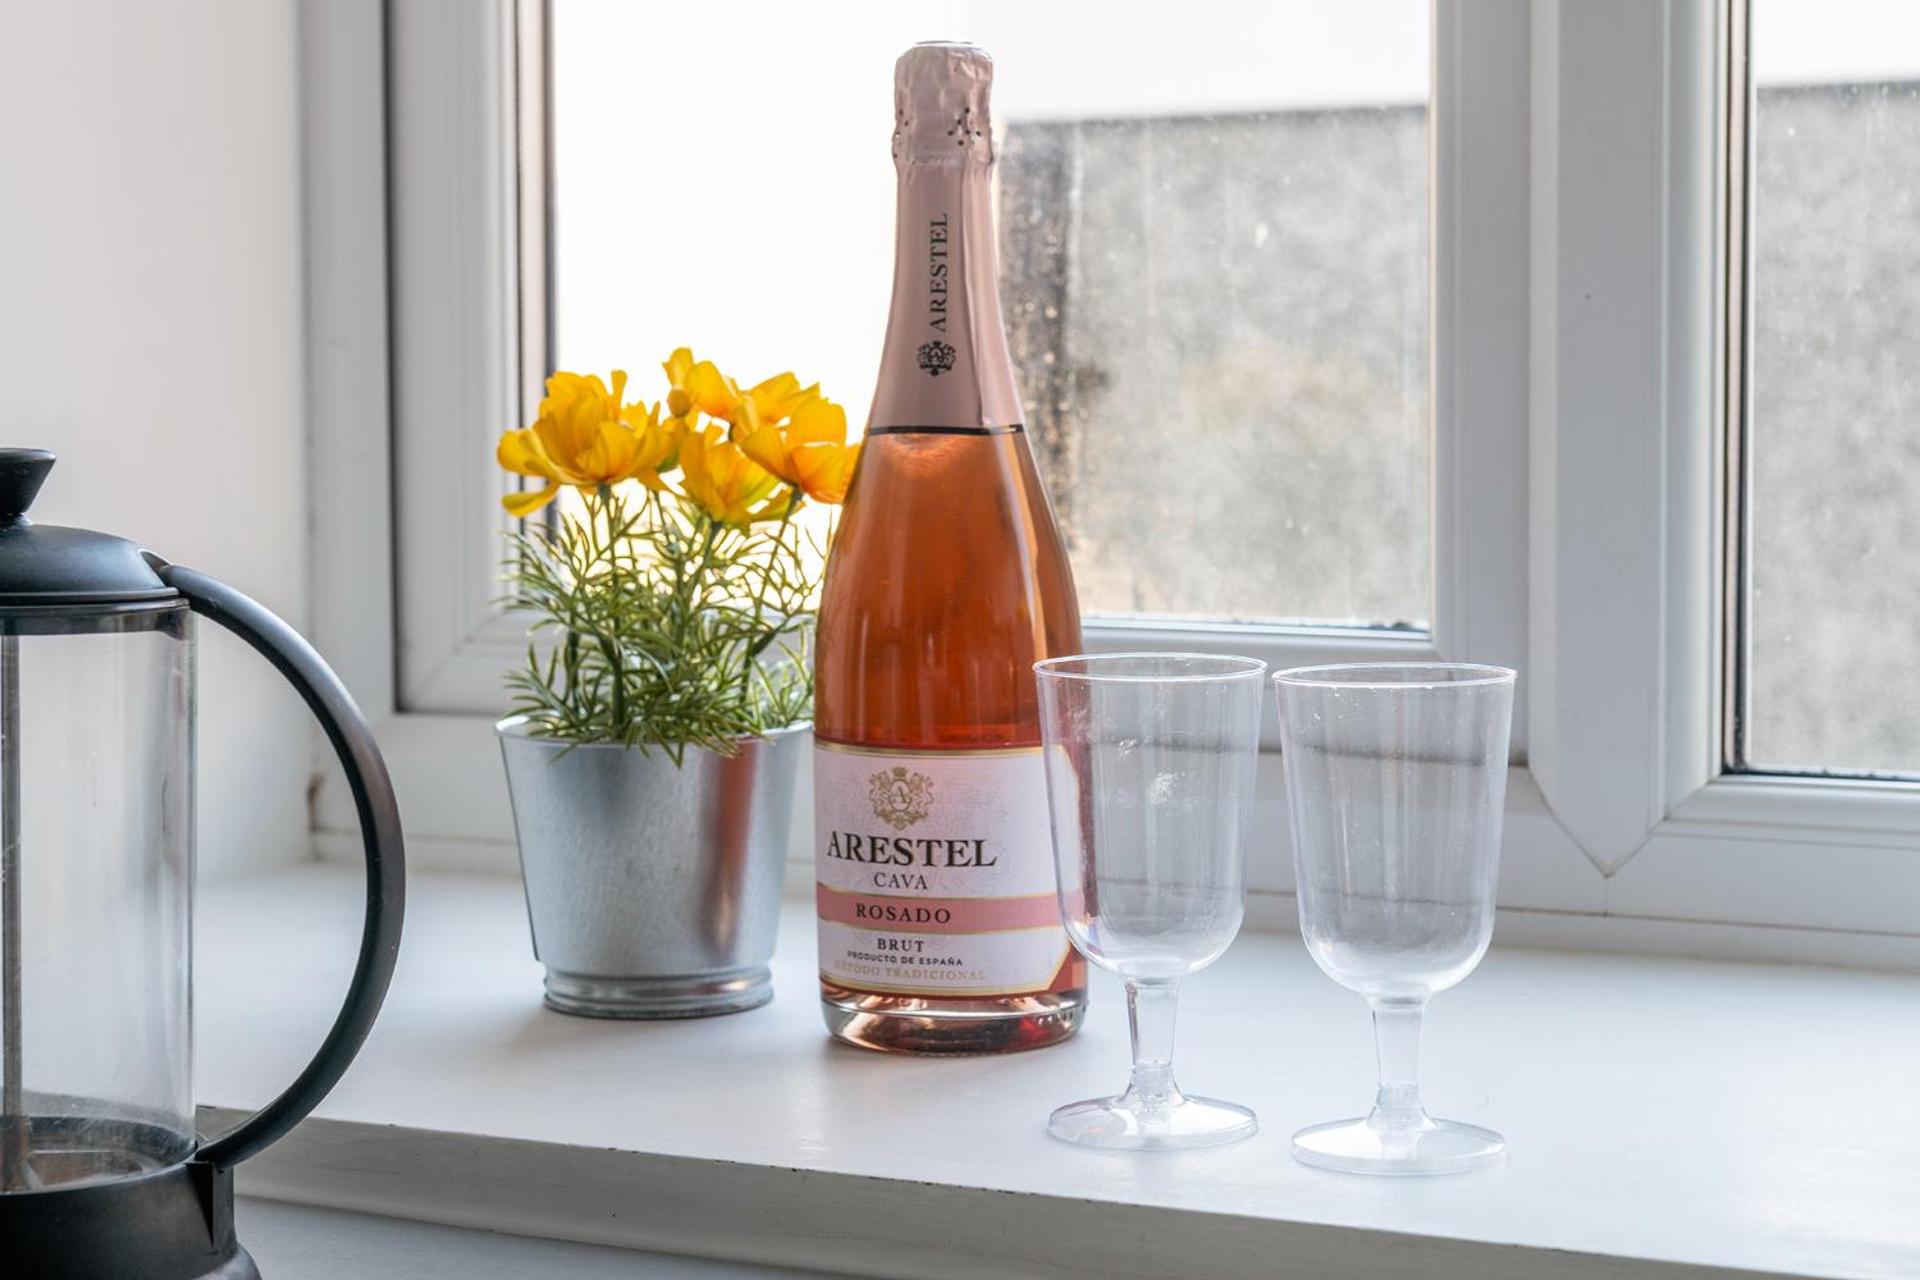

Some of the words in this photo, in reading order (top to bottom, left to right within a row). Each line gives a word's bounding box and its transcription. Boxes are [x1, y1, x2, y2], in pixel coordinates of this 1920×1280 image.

[929, 213, 948, 333] ARESTEL
[827, 830, 998, 867] ARESTEL
[874, 871, 928, 890] CAVA
[856, 903, 950, 924] ROSADO
[877, 938, 925, 952] BRUT
[847, 951, 897, 964] PRODUCTO
[901, 956, 914, 965] DE
[919, 956, 963, 966] ESPAÑA
[886, 966, 986, 981] TRADICIONAL
